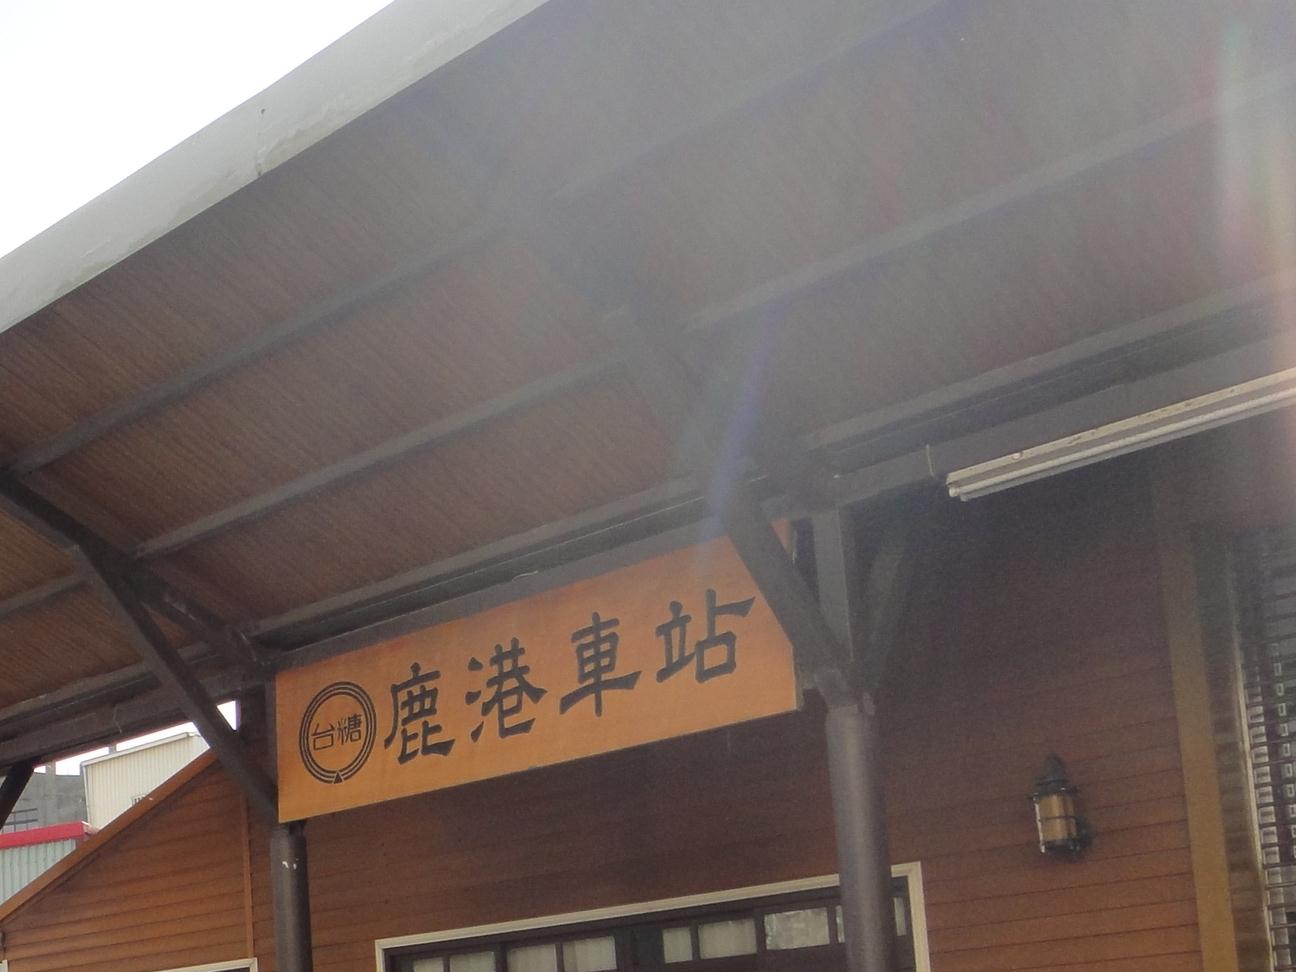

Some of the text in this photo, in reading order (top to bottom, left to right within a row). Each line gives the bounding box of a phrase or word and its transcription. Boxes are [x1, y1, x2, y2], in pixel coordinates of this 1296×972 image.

[384, 588, 756, 765] 鹿港車站
[310, 712, 363, 751] 台糖
